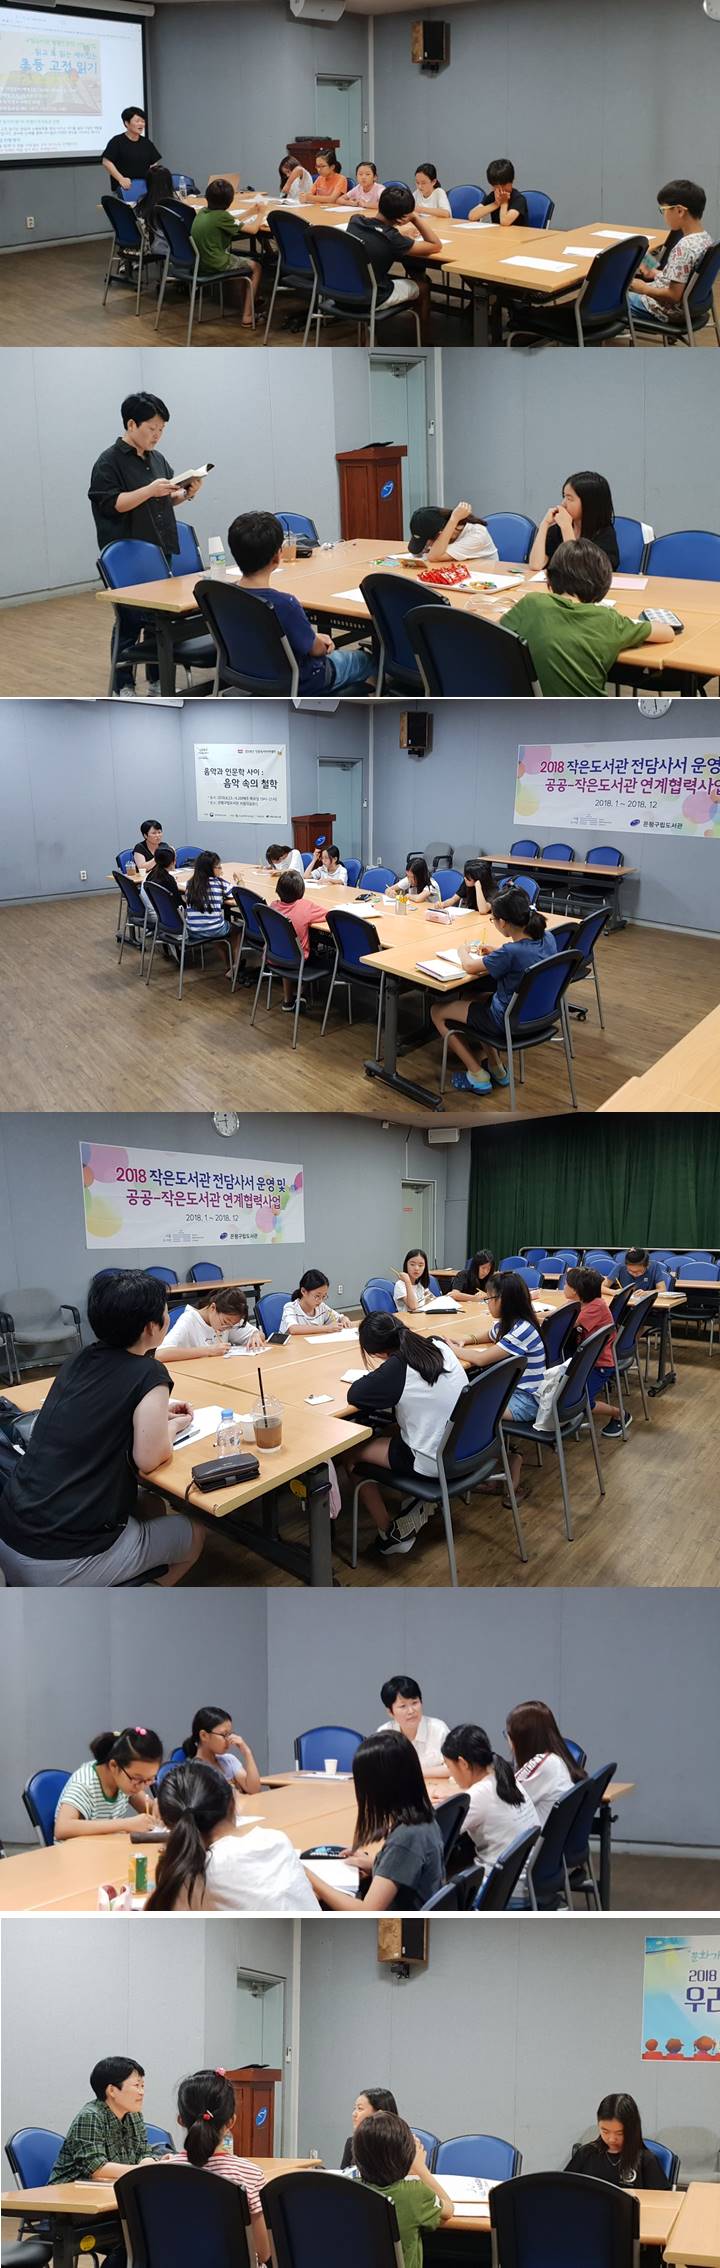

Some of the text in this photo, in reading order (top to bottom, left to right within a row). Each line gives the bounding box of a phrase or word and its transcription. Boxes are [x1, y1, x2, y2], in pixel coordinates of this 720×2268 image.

[204, 767, 223, 776] 음악과
[225, 768, 245, 776] 인문학
[247, 768, 260, 776] 사이
[540, 756, 720, 775] 2018 작은도서관 전담사서 운영
[223, 778, 279, 789] 음악 속의 철학
[545, 778, 638, 795] 공공-작은도서관
[116, 1167, 286, 1193] 2018 작은도서관 전담사서 운영 및
[126, 1188, 281, 1210] 공공-작은도서관 연계협력사업
[688, 1969, 717, 1982] 2018
